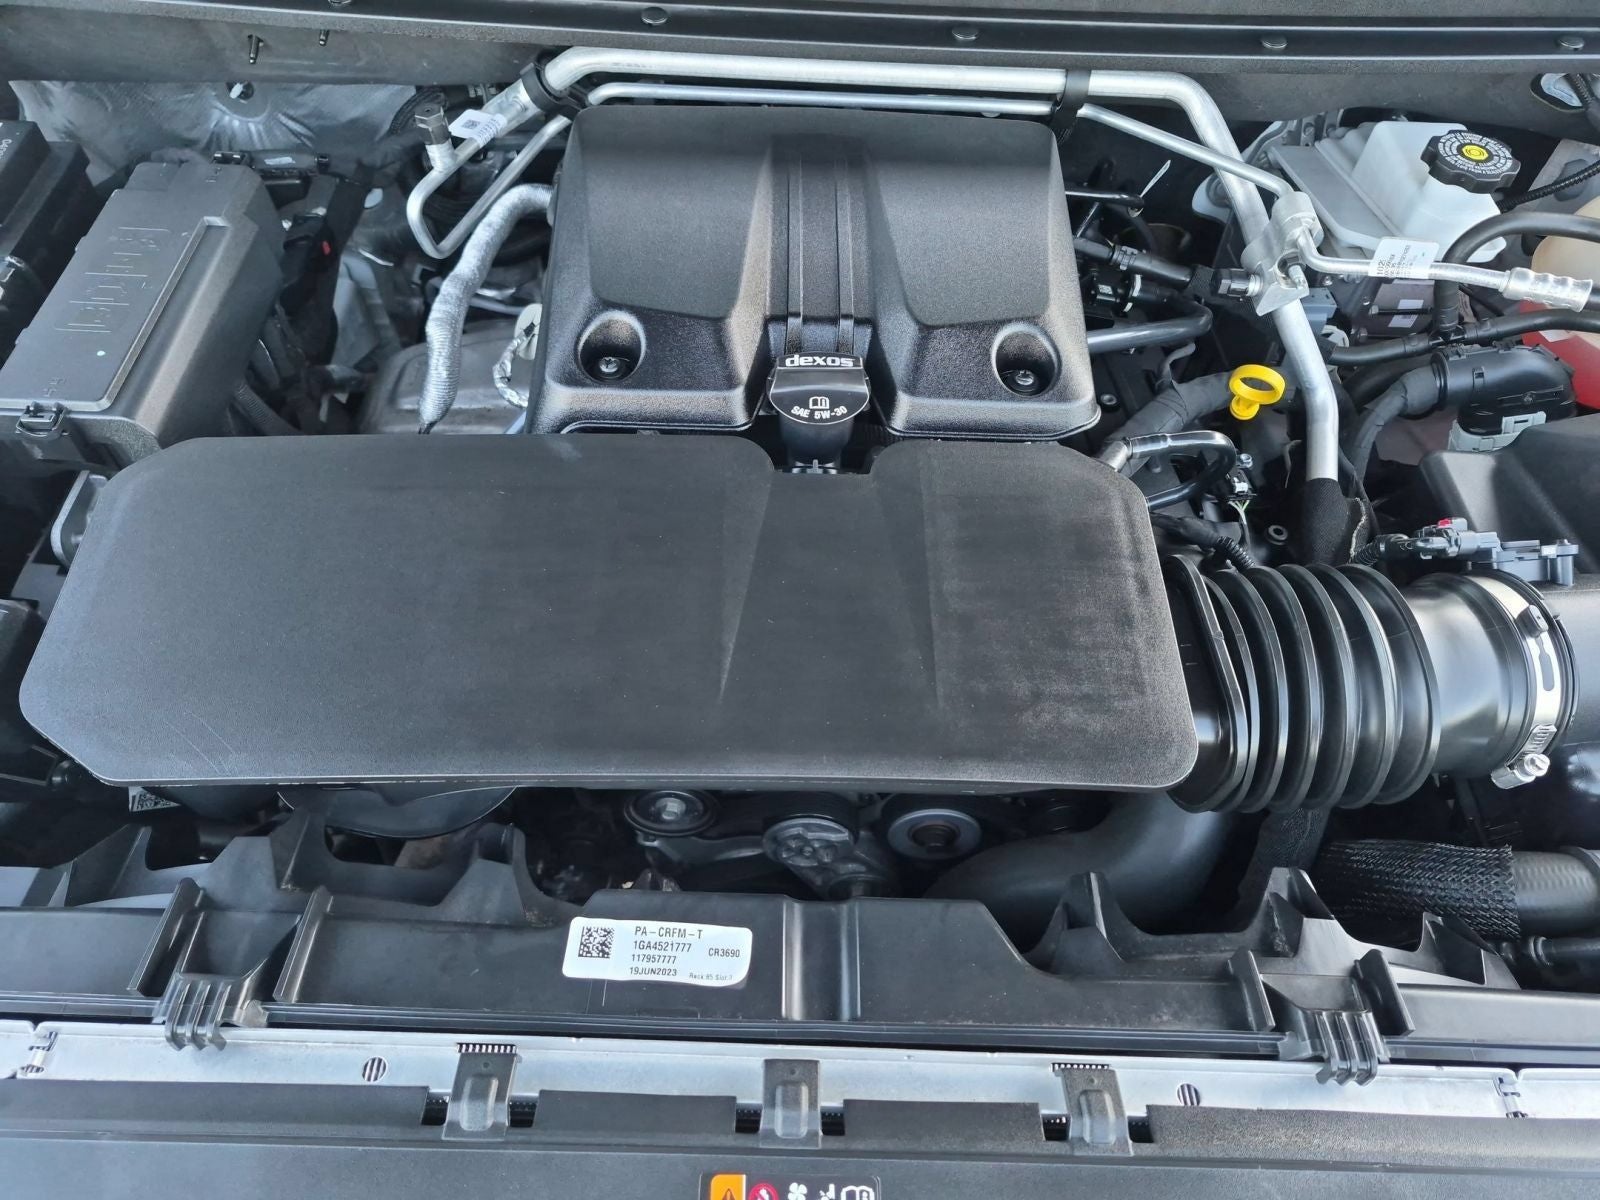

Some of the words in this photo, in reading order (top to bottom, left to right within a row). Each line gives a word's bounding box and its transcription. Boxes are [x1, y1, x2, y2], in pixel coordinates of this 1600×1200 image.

[785, 354, 855, 367] dexos
[791, 405, 810, 418] SAE
[814, 405, 848, 420] 5W-30
[633, 940, 692, 953] 1GA4521777
[708, 947, 741, 958] CR3690
[631, 953, 677, 965] 117957777
[629, 966, 677, 977] 19JUN2023
